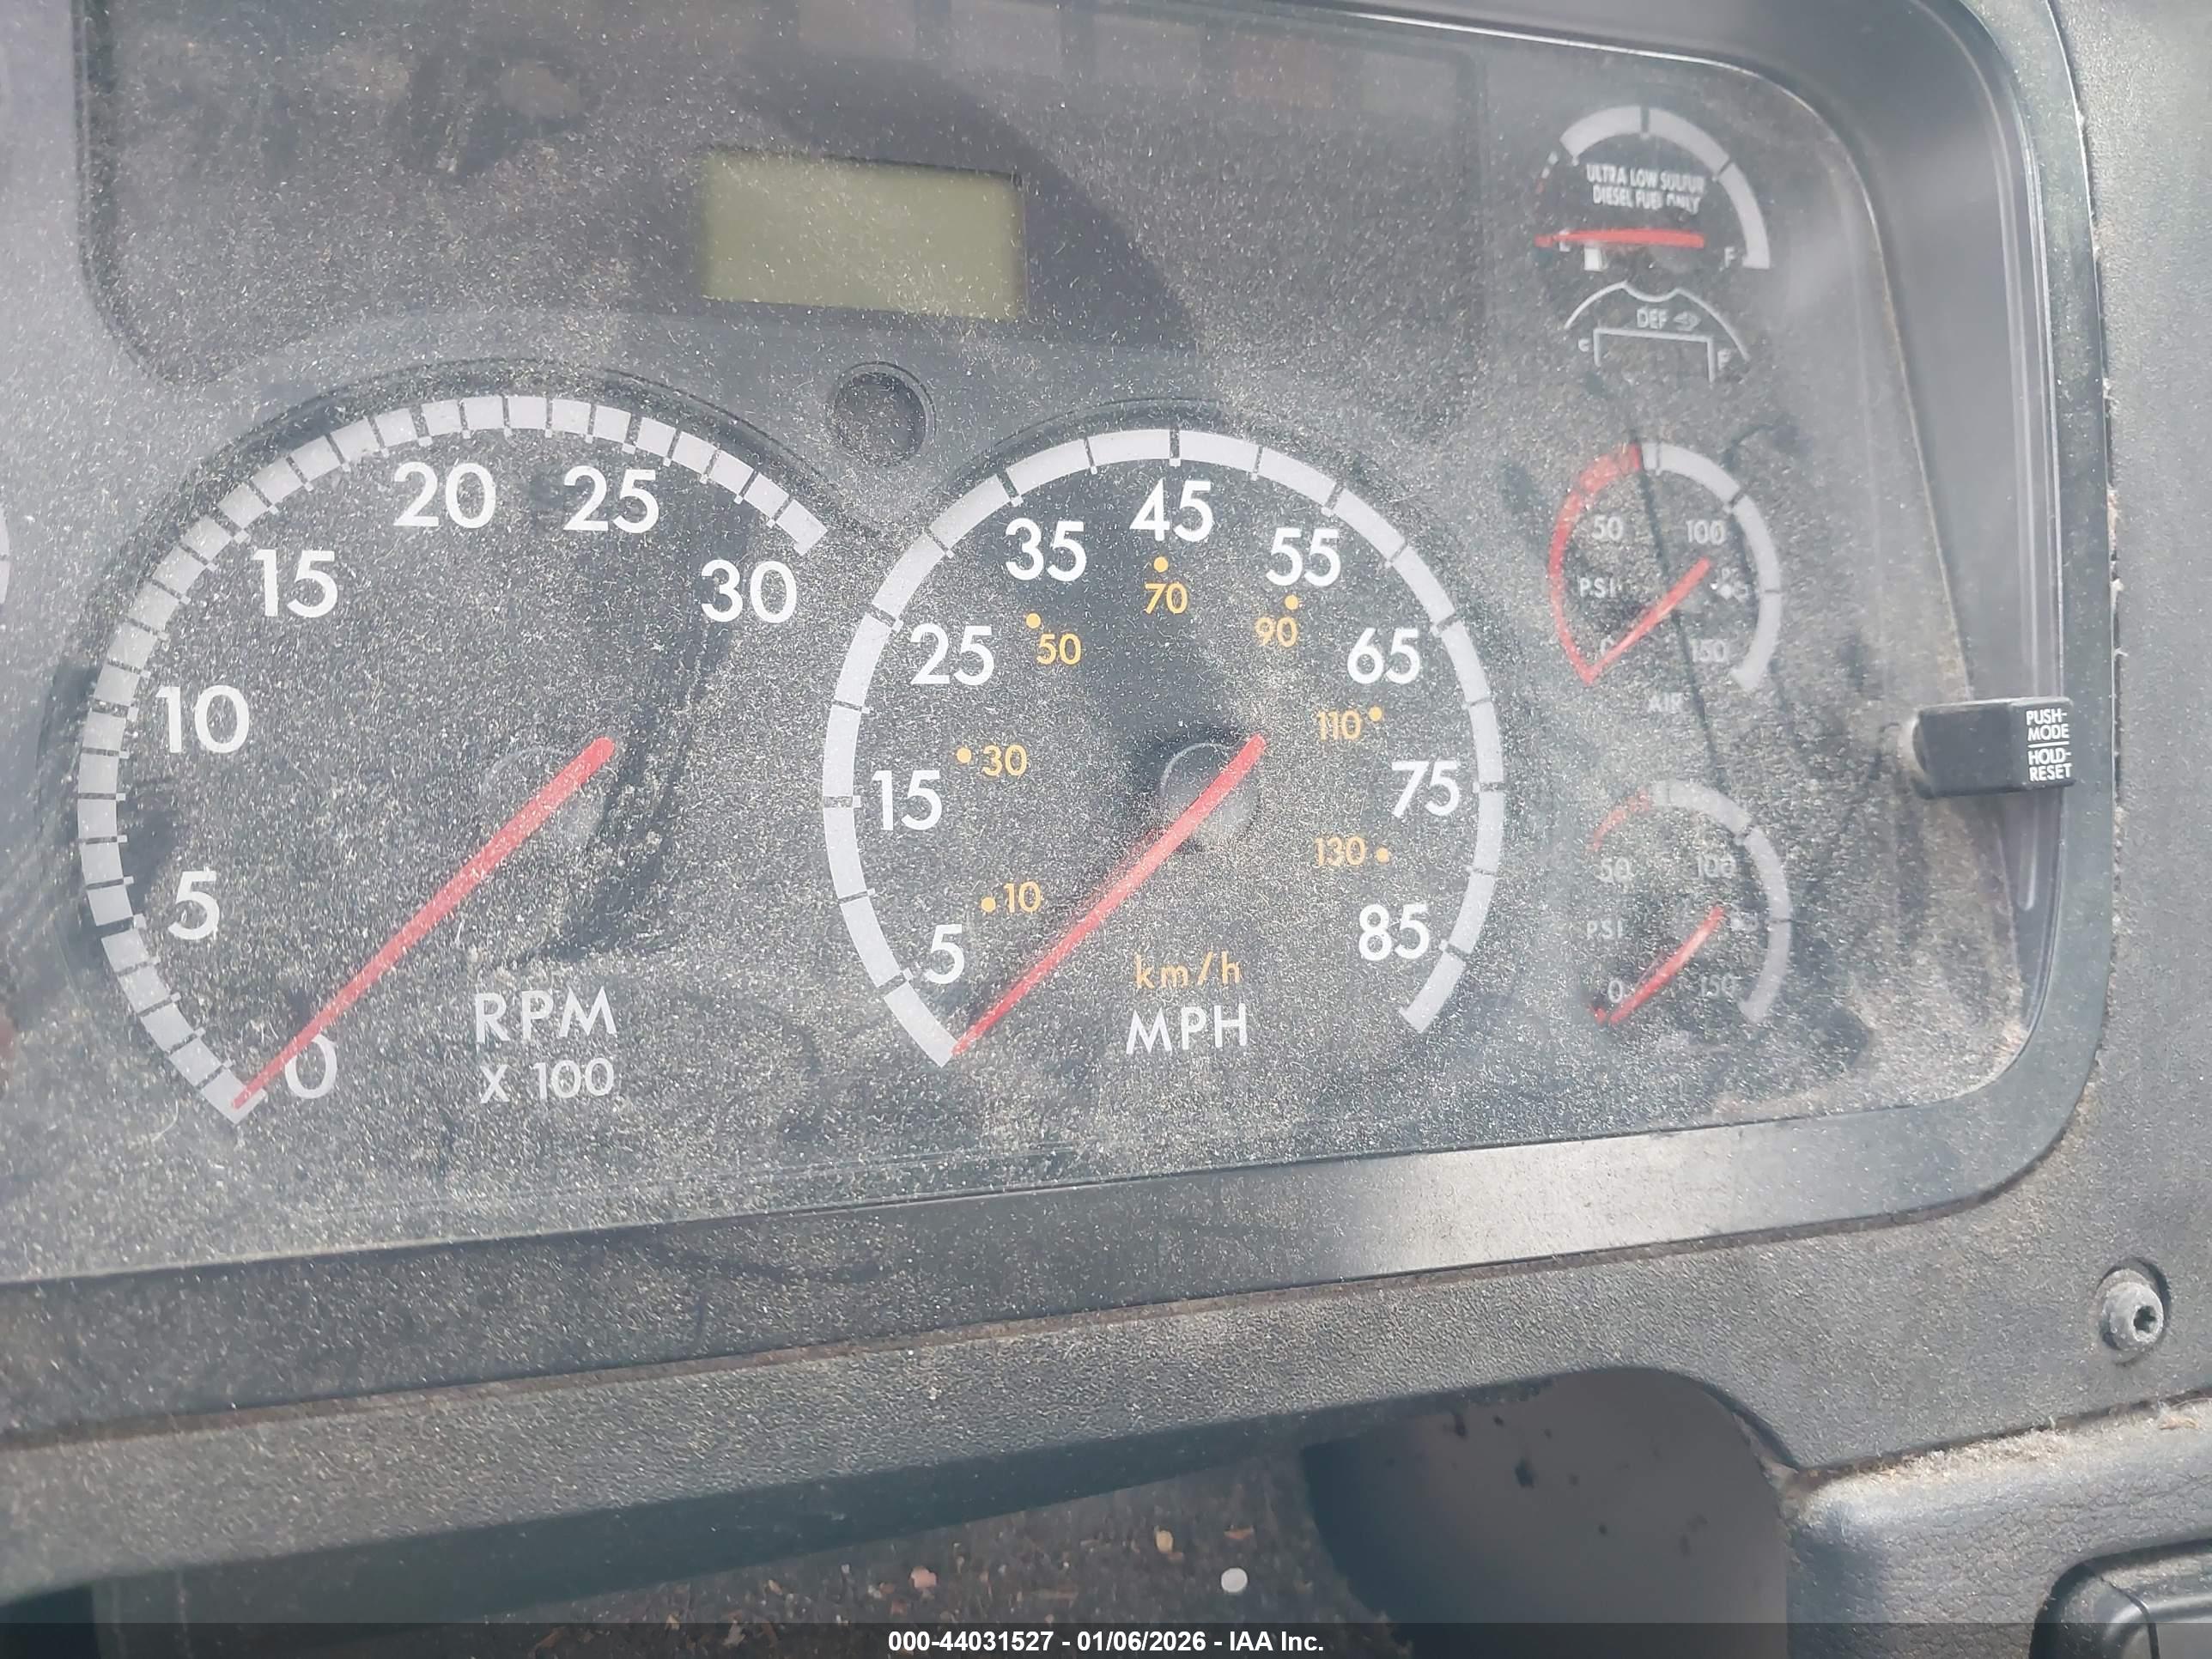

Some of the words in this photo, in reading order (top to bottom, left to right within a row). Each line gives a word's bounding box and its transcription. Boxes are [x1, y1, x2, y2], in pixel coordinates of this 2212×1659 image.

[1587, 164, 1627, 185] ULTRA
[1630, 168, 1658, 188] LOW
[1661, 171, 1705, 194] SULFUR
[1593, 185, 1633, 208] DIESEL
[1635, 189, 1663, 210] FUEL
[1666, 192, 1701, 215] ONLY
[1724, 246, 1735, 268] F
[1637, 308, 1668, 330] DEF
[393, 462, 496, 528] 20
[563, 465, 659, 534] 25
[1129, 477, 1213, 543] 45
[1591, 516, 1624, 543] 50
[1686, 520, 1727, 544] 100
[1006, 518, 1087, 582] 35
[1266, 527, 1341, 586] 55
[251, 550, 338, 617] 15
[702, 559, 797, 623] 30
[1144, 583, 1188, 615] 70
[1579, 577, 1616, 599] PSI
[1255, 617, 1297, 647] 90
[910, 623, 994, 685] 25
[1036, 634, 1081, 665] 50
[1347, 628, 1421, 684] 65
[156, 685, 249, 753] 10
[1317, 709, 1362, 741] 110
[2026, 708, 2067, 726] PUSH-
[2027, 723, 2070, 741] MODE
[982, 744, 1028, 777] 30
[2028, 748, 2071, 765] HOLD-
[2029, 763, 2072, 781] RESET
[871, 769, 943, 830] 15
[1392, 760, 1461, 817] 75
[1314, 836, 1366, 866] 130
[1595, 857, 1632, 884] 50
[167, 870, 220, 940] 5
[1005, 882, 1042, 913] 10
[1358, 903, 1431, 962] 85
[1587, 919, 1624, 939] PSI
[925, 923, 965, 985] 5
[1135, 950, 1242, 990] km/h
[1608, 981, 1624, 1004] 0
[476, 986, 617, 1043] RPM
[1126, 1003, 1248, 1055] MPH
[283, 1032, 338, 1099] 0
[533, 1057, 615, 1101] 100
